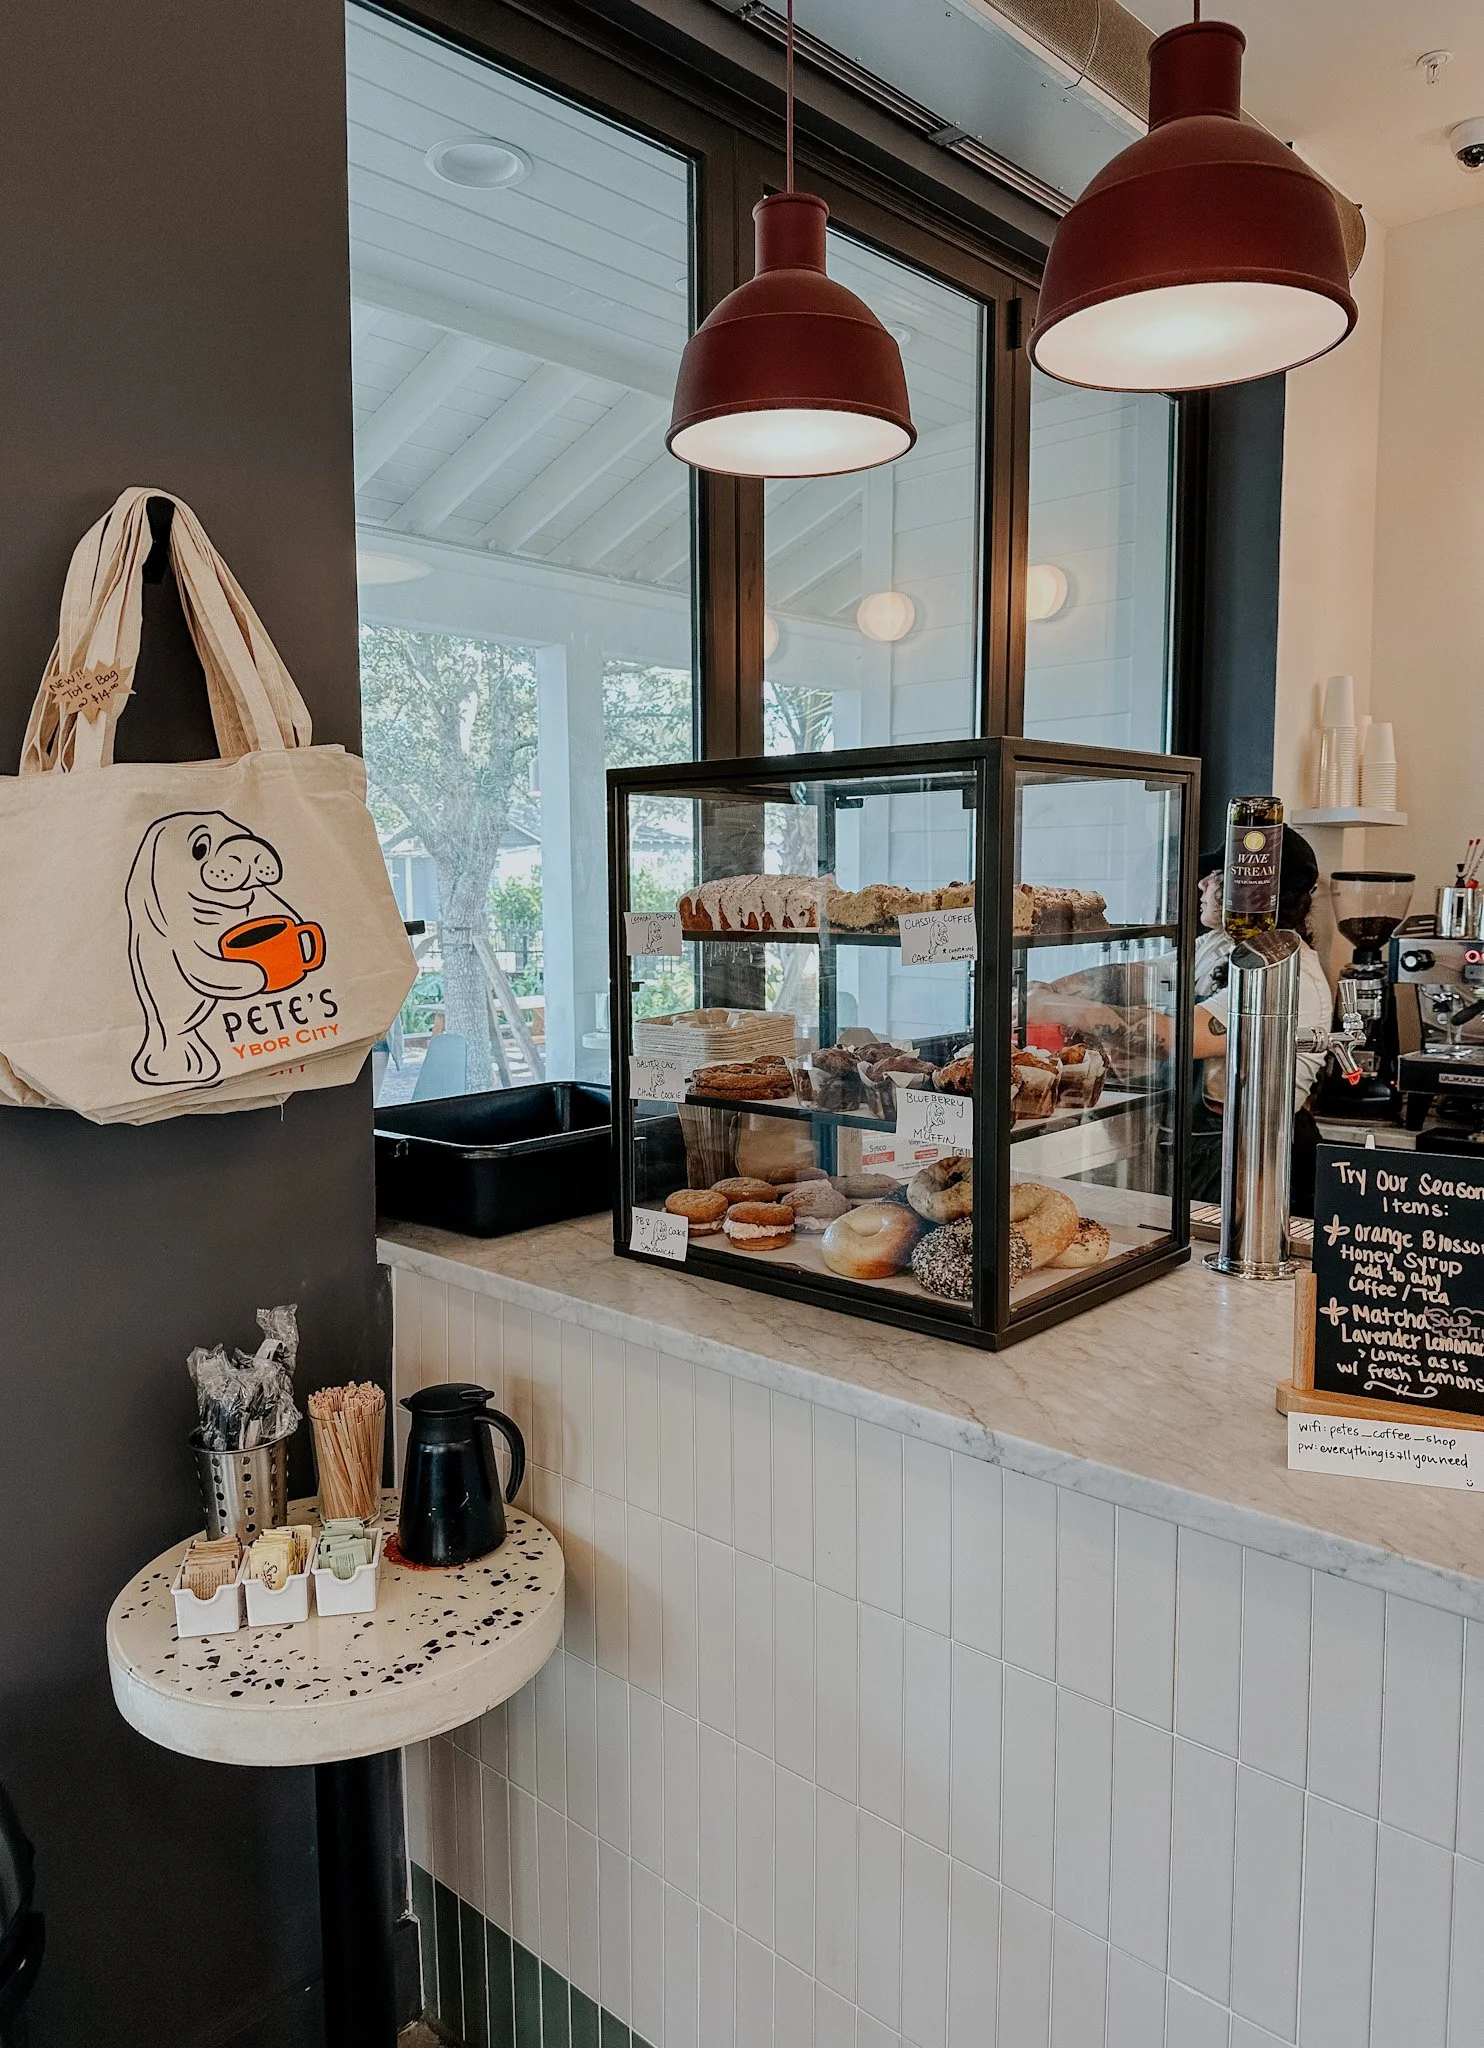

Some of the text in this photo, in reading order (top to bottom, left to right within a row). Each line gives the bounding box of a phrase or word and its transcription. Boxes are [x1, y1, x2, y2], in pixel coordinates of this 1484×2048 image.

[62, 670, 119, 699] Tote Bag
[1238, 853, 1270, 864] WINE
[1230, 865, 1276, 877] STREAM
[904, 912, 973, 930] CLASSIC COFFEE
[911, 953, 934, 963] CAKE
[222, 988, 339, 1043] PETE'S
[232, 1023, 339, 1060] YBOR CITY
[906, 1092, 964, 1118] BLUEBERRY
[913, 1128, 956, 1145] MUFFIN
[869, 1144, 887, 1153] Sysco
[1331, 1161, 1367, 1196] Try
[1376, 1169, 1409, 1193] Our
[1383, 1196, 1449, 1217] Items:
[1354, 1223, 1484, 1255] Orange Blosso
[1339, 1244, 1463, 1278] Honey Syrup
[1348, 1276, 1398, 1299] Coffee
[1354, 1262, 1442, 1293] Add to any
[1351, 1303, 1432, 1330] Matcha
[1430, 1313, 1472, 1328] SOLD
[1341, 1322, 1422, 1350] Lavender
[1336, 1360, 1359, 1376] w/
[1428, 1356, 1450, 1370] as
